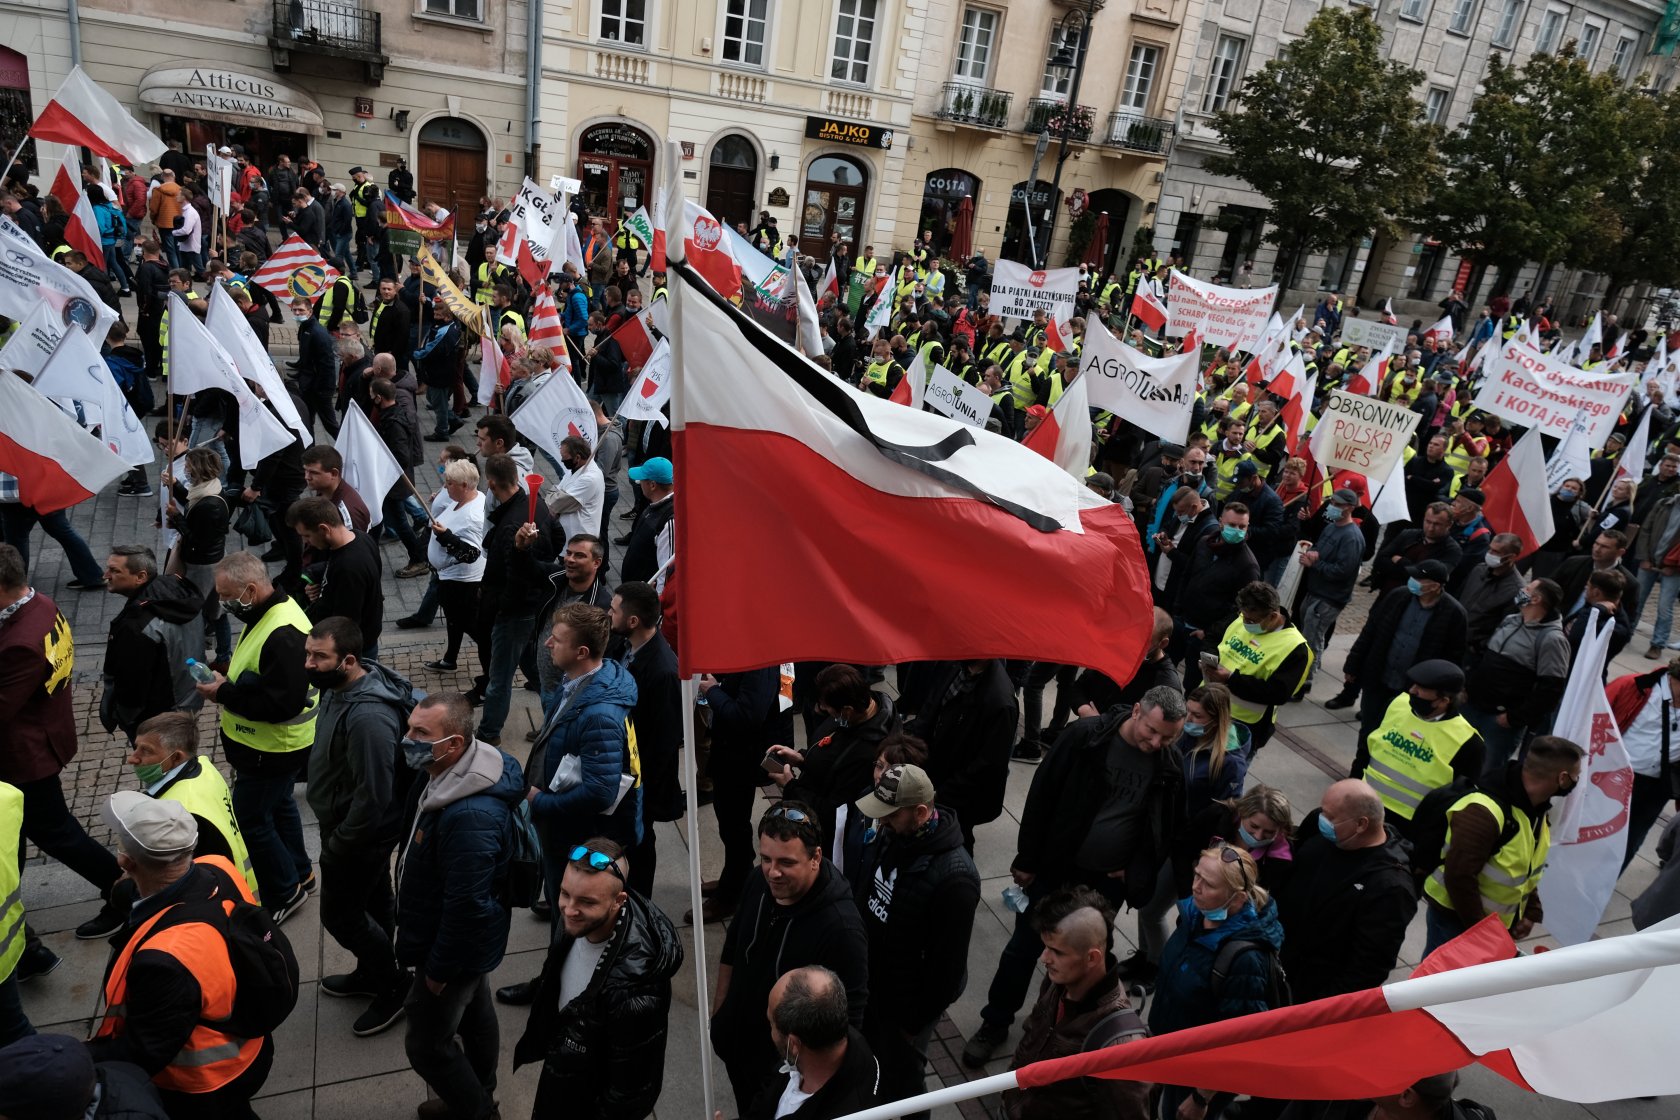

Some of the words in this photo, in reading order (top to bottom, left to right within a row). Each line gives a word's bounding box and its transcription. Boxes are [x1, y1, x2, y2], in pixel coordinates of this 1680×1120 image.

[187, 69, 275, 98] Atticus
[172, 92, 293, 118] ANTYKWARIAT
[360, 104, 370, 114] 12
[819, 132, 844, 141] BISTRO
[852, 137, 869, 145] CAFE
[820, 121, 870, 138] JAJKO
[684, 147, 692, 156] 10
[929, 177, 966, 192] COSTA
[1030, 272, 1045, 284] NIE
[991, 284, 1006, 295] DLA
[1008, 286, 1031, 299] PIĄTKI
[1032, 286, 1074, 304] KACZYŃSKIEGO
[1014, 297, 1024, 307] BO
[1025, 299, 1053, 311] ZNISZCZY
[1181, 297, 1197, 306] nam
[1001, 305, 1029, 318] ROLNIKA
[1504, 347, 1547, 373] STOP
[1546, 370, 1630, 398] dyktatury
[1501, 369, 1611, 417] Kaczyńskiego
[1328, 395, 1414, 434] OBRONIMY
[1494, 391, 1502, 405] i
[1504, 395, 1548, 422] KOTA
[1333, 419, 1393, 454] POLSKA
[1334, 442, 1373, 468] WIEŚ
[868, 894, 889, 924] dida
